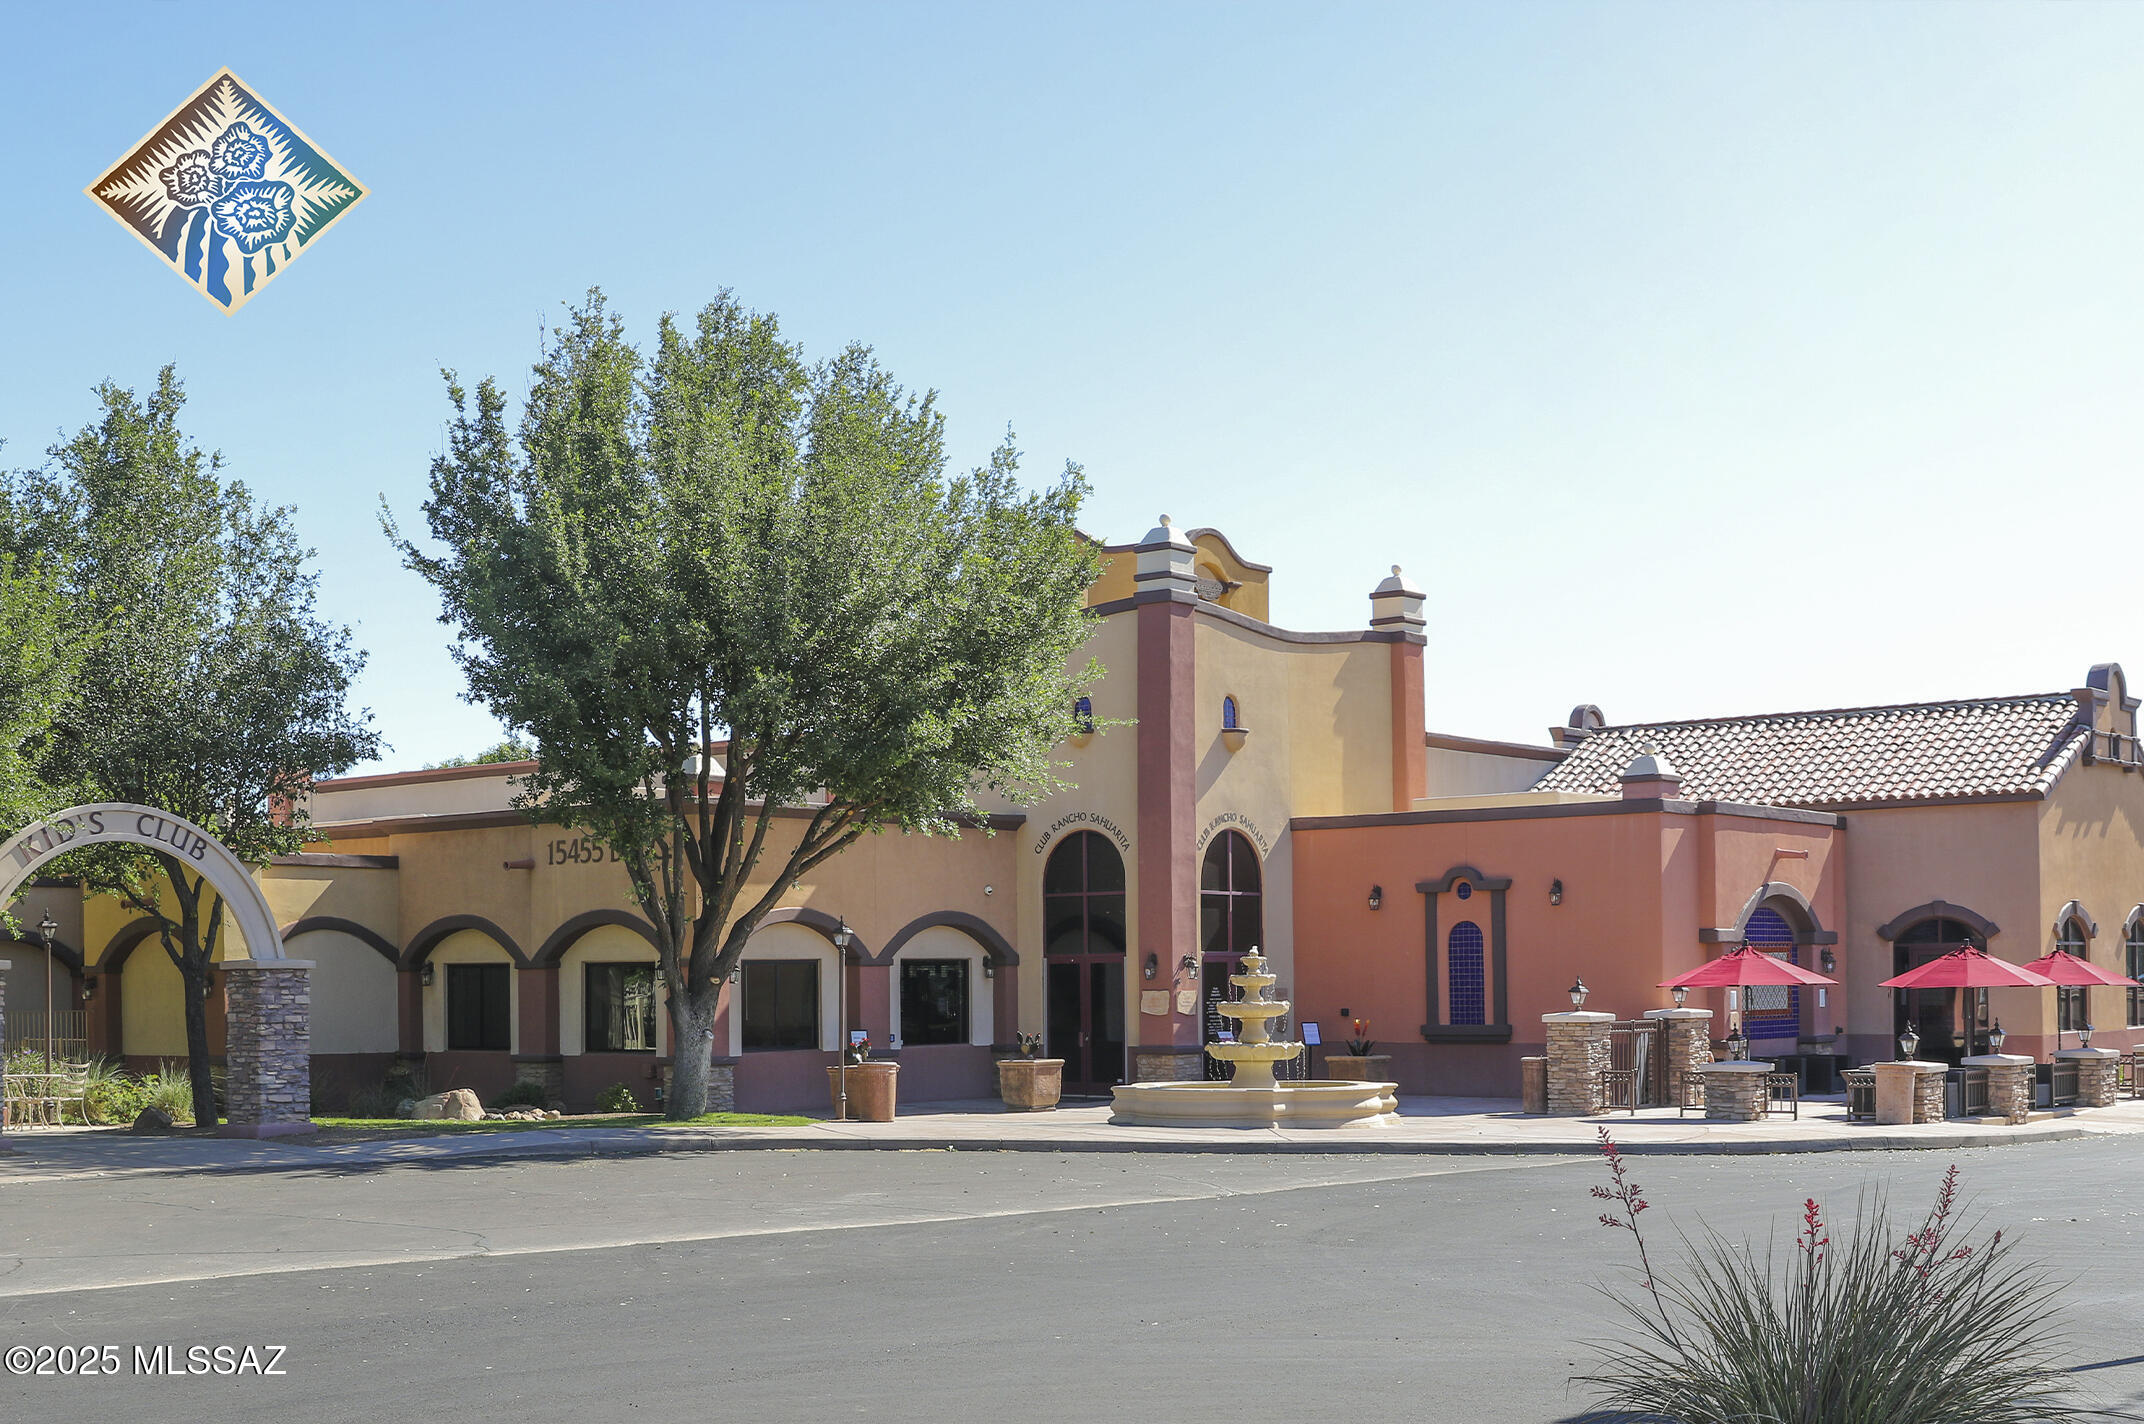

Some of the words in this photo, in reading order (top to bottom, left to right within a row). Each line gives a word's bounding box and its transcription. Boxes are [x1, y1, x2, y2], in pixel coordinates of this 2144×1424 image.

[17, 811, 105, 864] KID'S
[136, 814, 208, 861] CLUB
[547, 838, 604, 866] 15455
[1034, 831, 1051, 854] CLUB
[1051, 812, 1087, 833] RANCHO
[1089, 812, 1130, 852] SAHUARITA
[1196, 828, 1211, 851] CLUB
[1209, 812, 1237, 831] RANCHO
[1239, 814, 1269, 857] SAHUARITA
